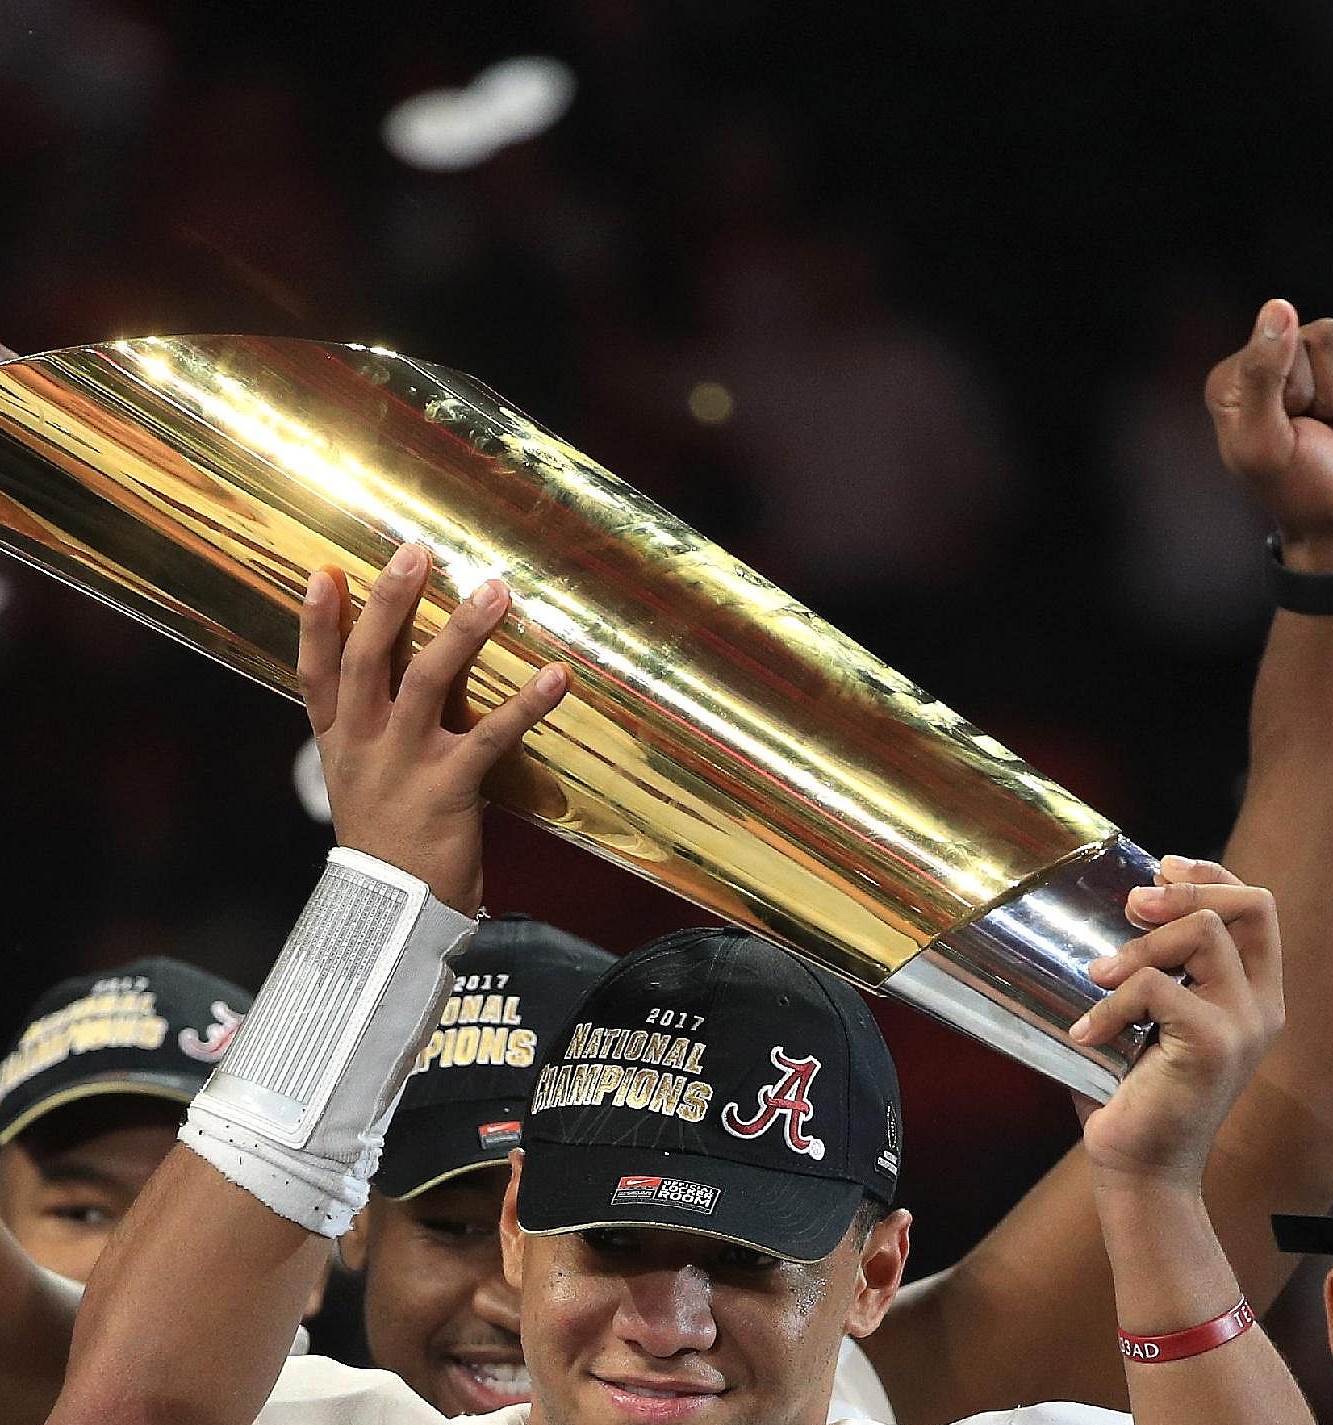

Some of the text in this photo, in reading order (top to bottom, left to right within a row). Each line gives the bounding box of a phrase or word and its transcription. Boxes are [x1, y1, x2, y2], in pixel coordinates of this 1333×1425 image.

[452, 974, 510, 992] 2017
[645, 1008, 705, 1031] 2017
[564, 1021, 707, 1075] NATIONAL
[657, 1190, 711, 1207] ROOM
